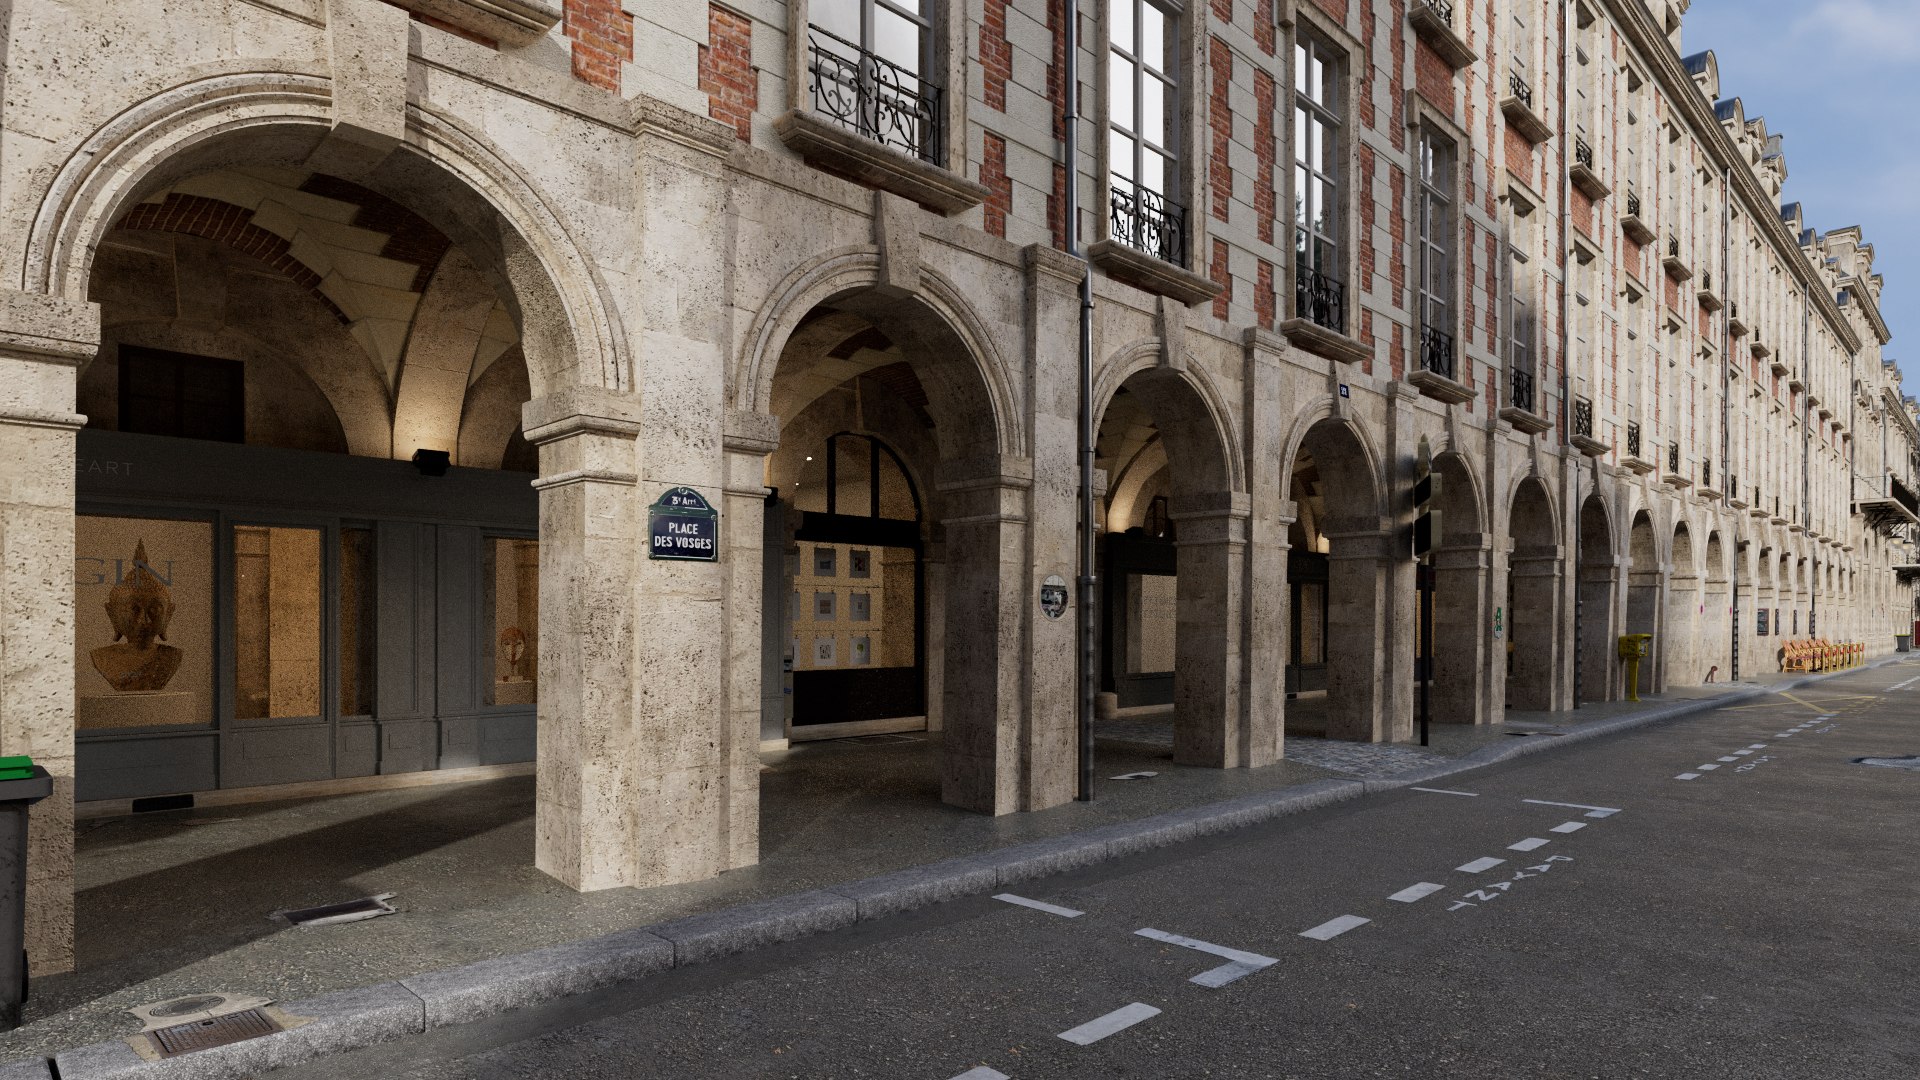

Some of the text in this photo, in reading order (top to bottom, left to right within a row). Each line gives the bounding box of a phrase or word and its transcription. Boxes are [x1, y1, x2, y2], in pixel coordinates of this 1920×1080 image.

[669, 522, 699, 535] PLACE
[654, 535, 712, 550] DES VOSGES
[1446, 855, 1574, 912] PAYANT
